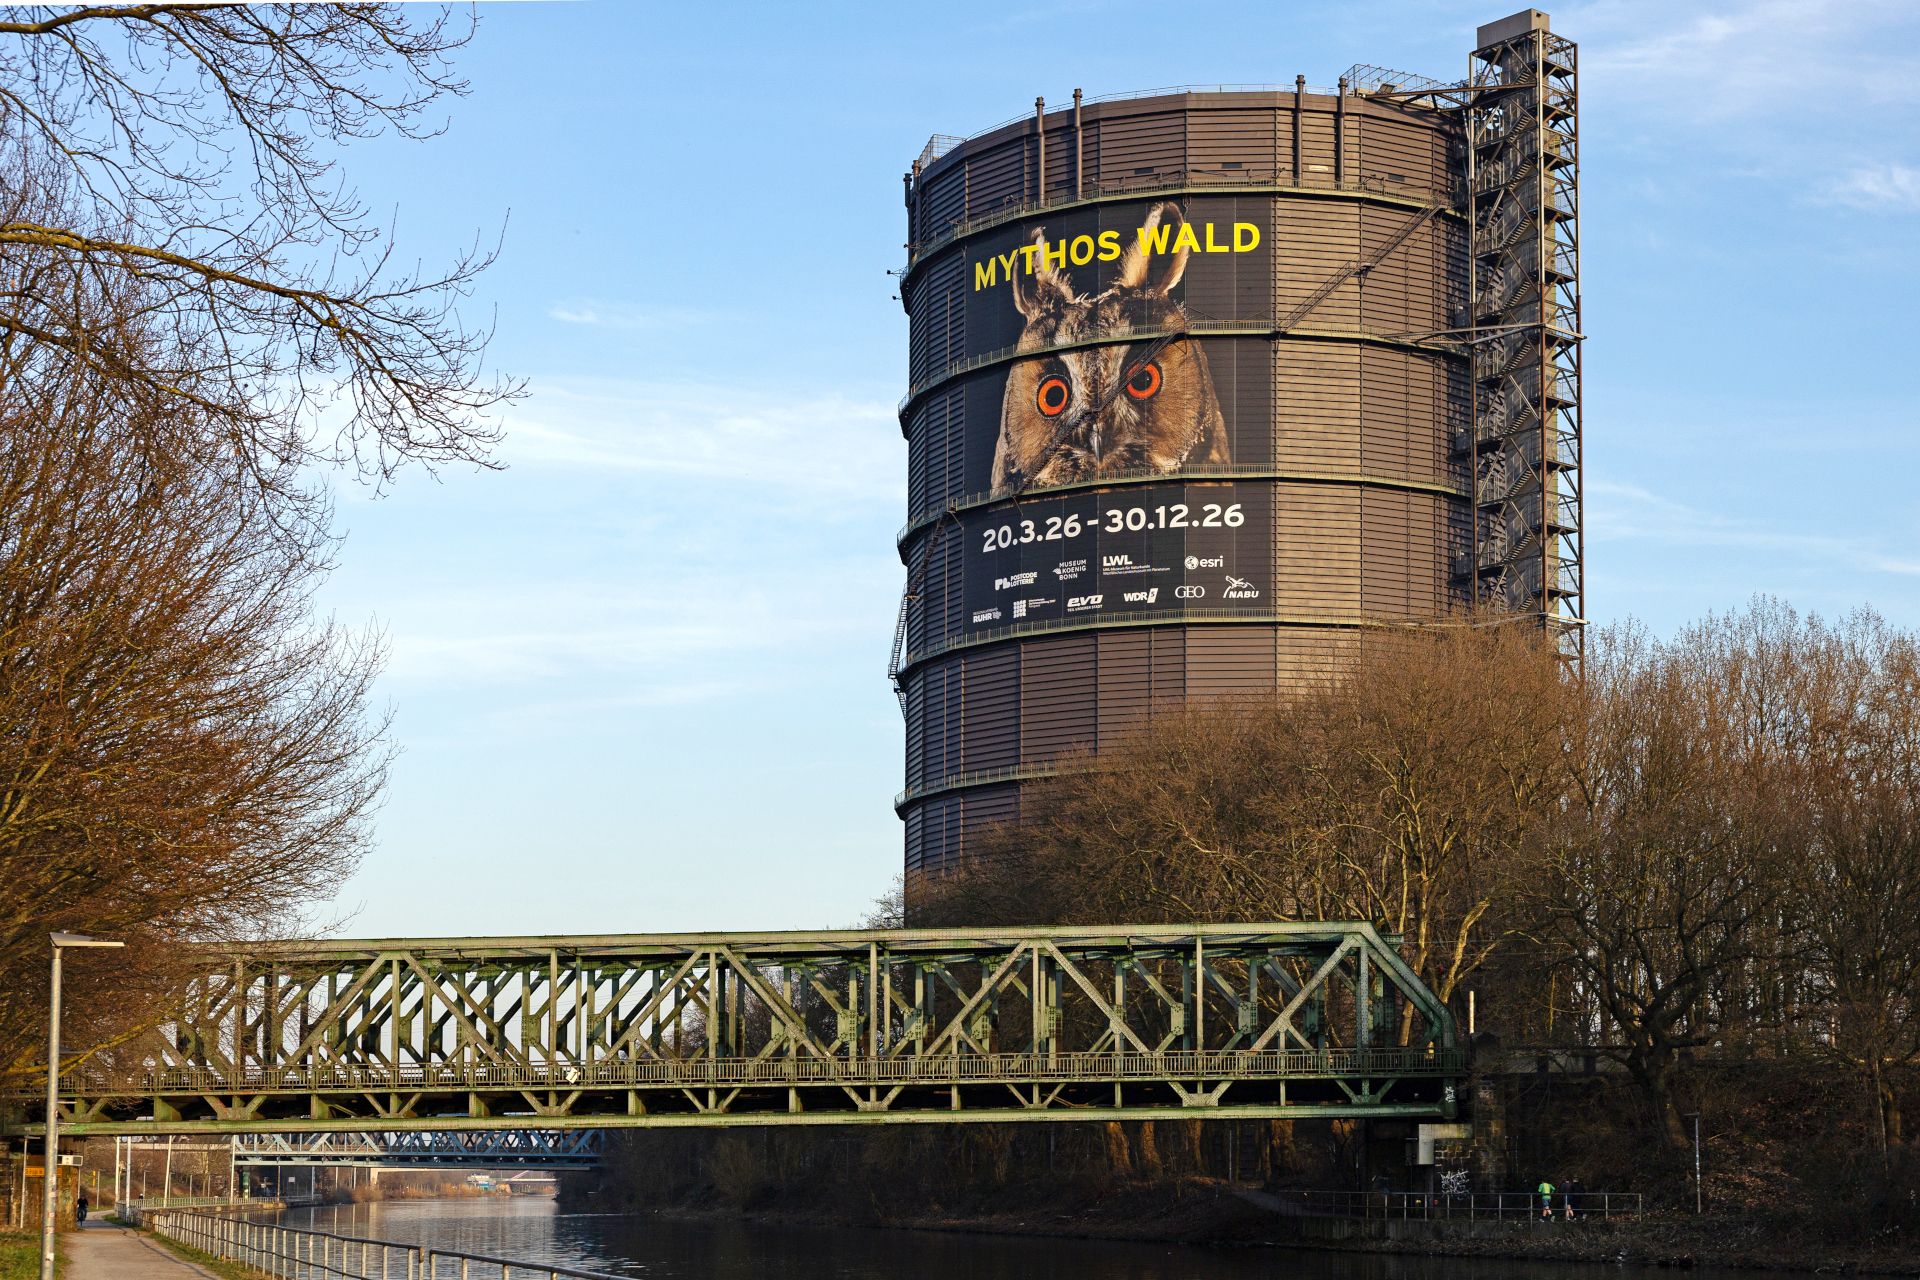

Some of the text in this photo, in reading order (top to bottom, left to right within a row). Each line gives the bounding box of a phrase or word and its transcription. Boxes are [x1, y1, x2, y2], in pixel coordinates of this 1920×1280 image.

[975, 222, 1261, 291] MYTHOS WALD
[1058, 559, 1087, 568] MUSEUM
[1102, 554, 1133, 567] LWL
[1199, 555, 1224, 568] esri
[1061, 565, 1087, 574] KOENIG
[1010, 571, 1038, 582] POSTCODE
[1058, 572, 1078, 581] BONN
[1010, 577, 1035, 588] LOTTERIE
[1123, 591, 1148, 602] WDR
[1174, 585, 1205, 599] GEO
[1228, 590, 1260, 599] NABU
[972, 611, 993, 624] RUHR
